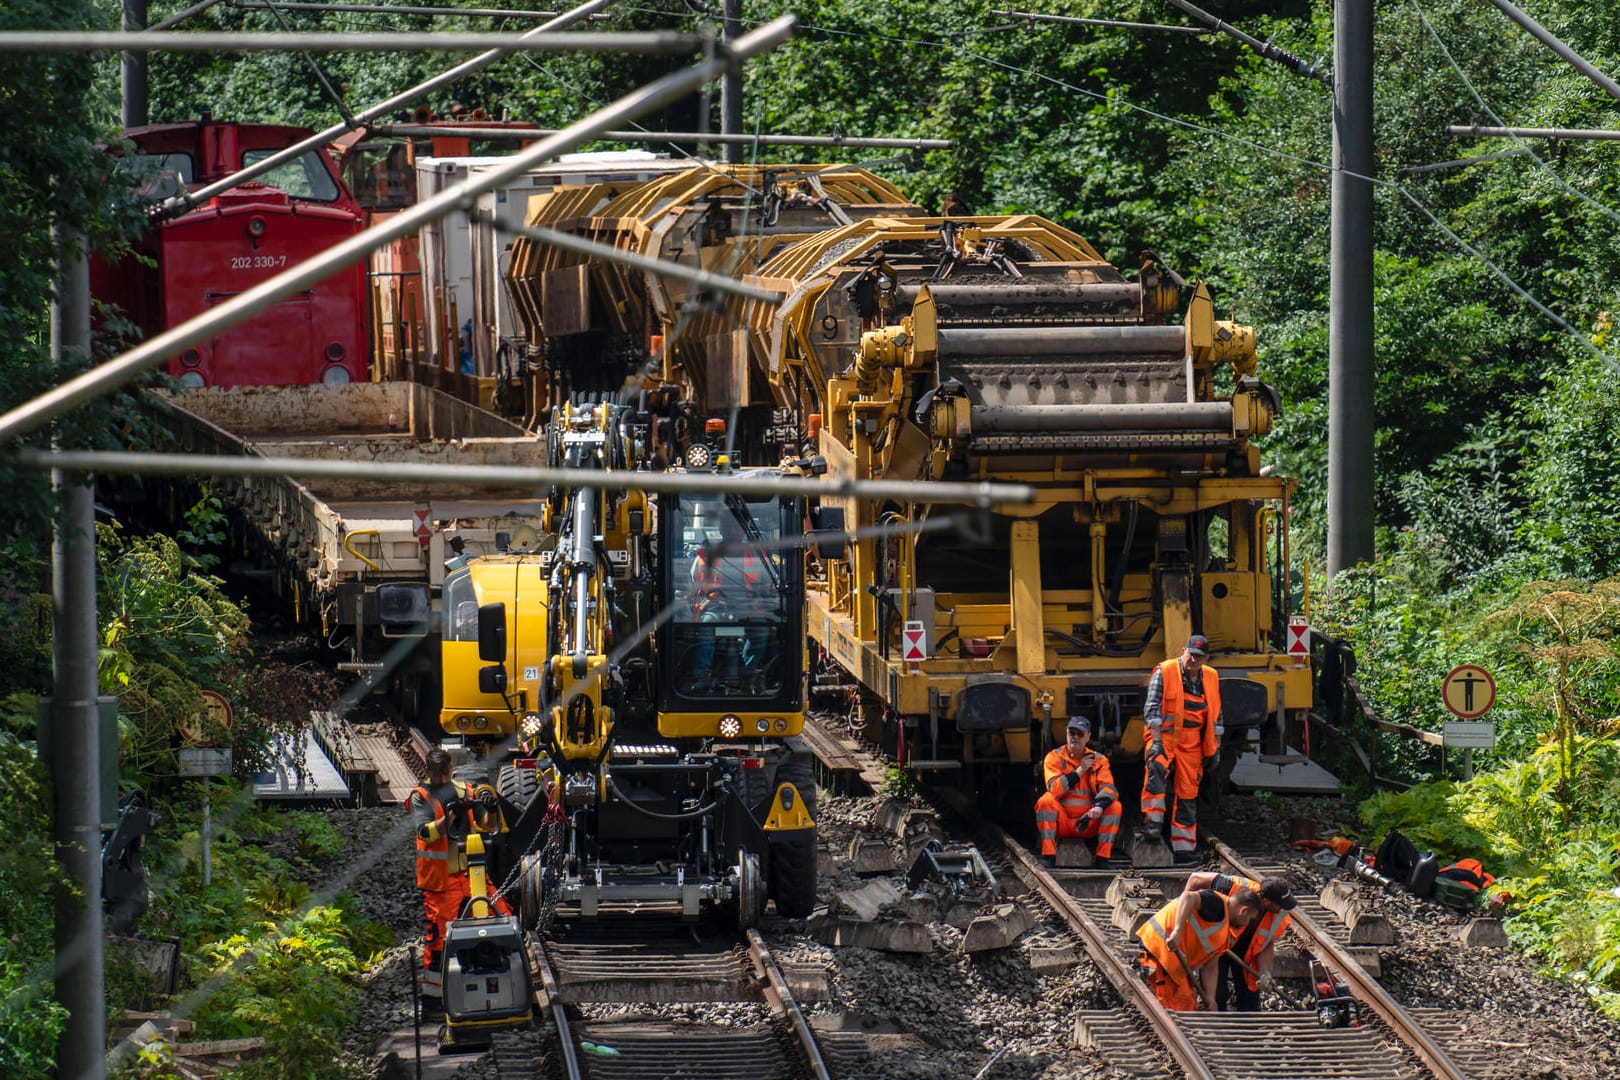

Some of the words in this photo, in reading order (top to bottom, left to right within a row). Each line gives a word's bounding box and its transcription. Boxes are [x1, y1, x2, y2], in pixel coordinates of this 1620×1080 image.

[231, 256, 252, 269] 202
[254, 255, 287, 268] 330-7
[822, 315, 838, 340] 9
[526, 669, 537, 679] 21
